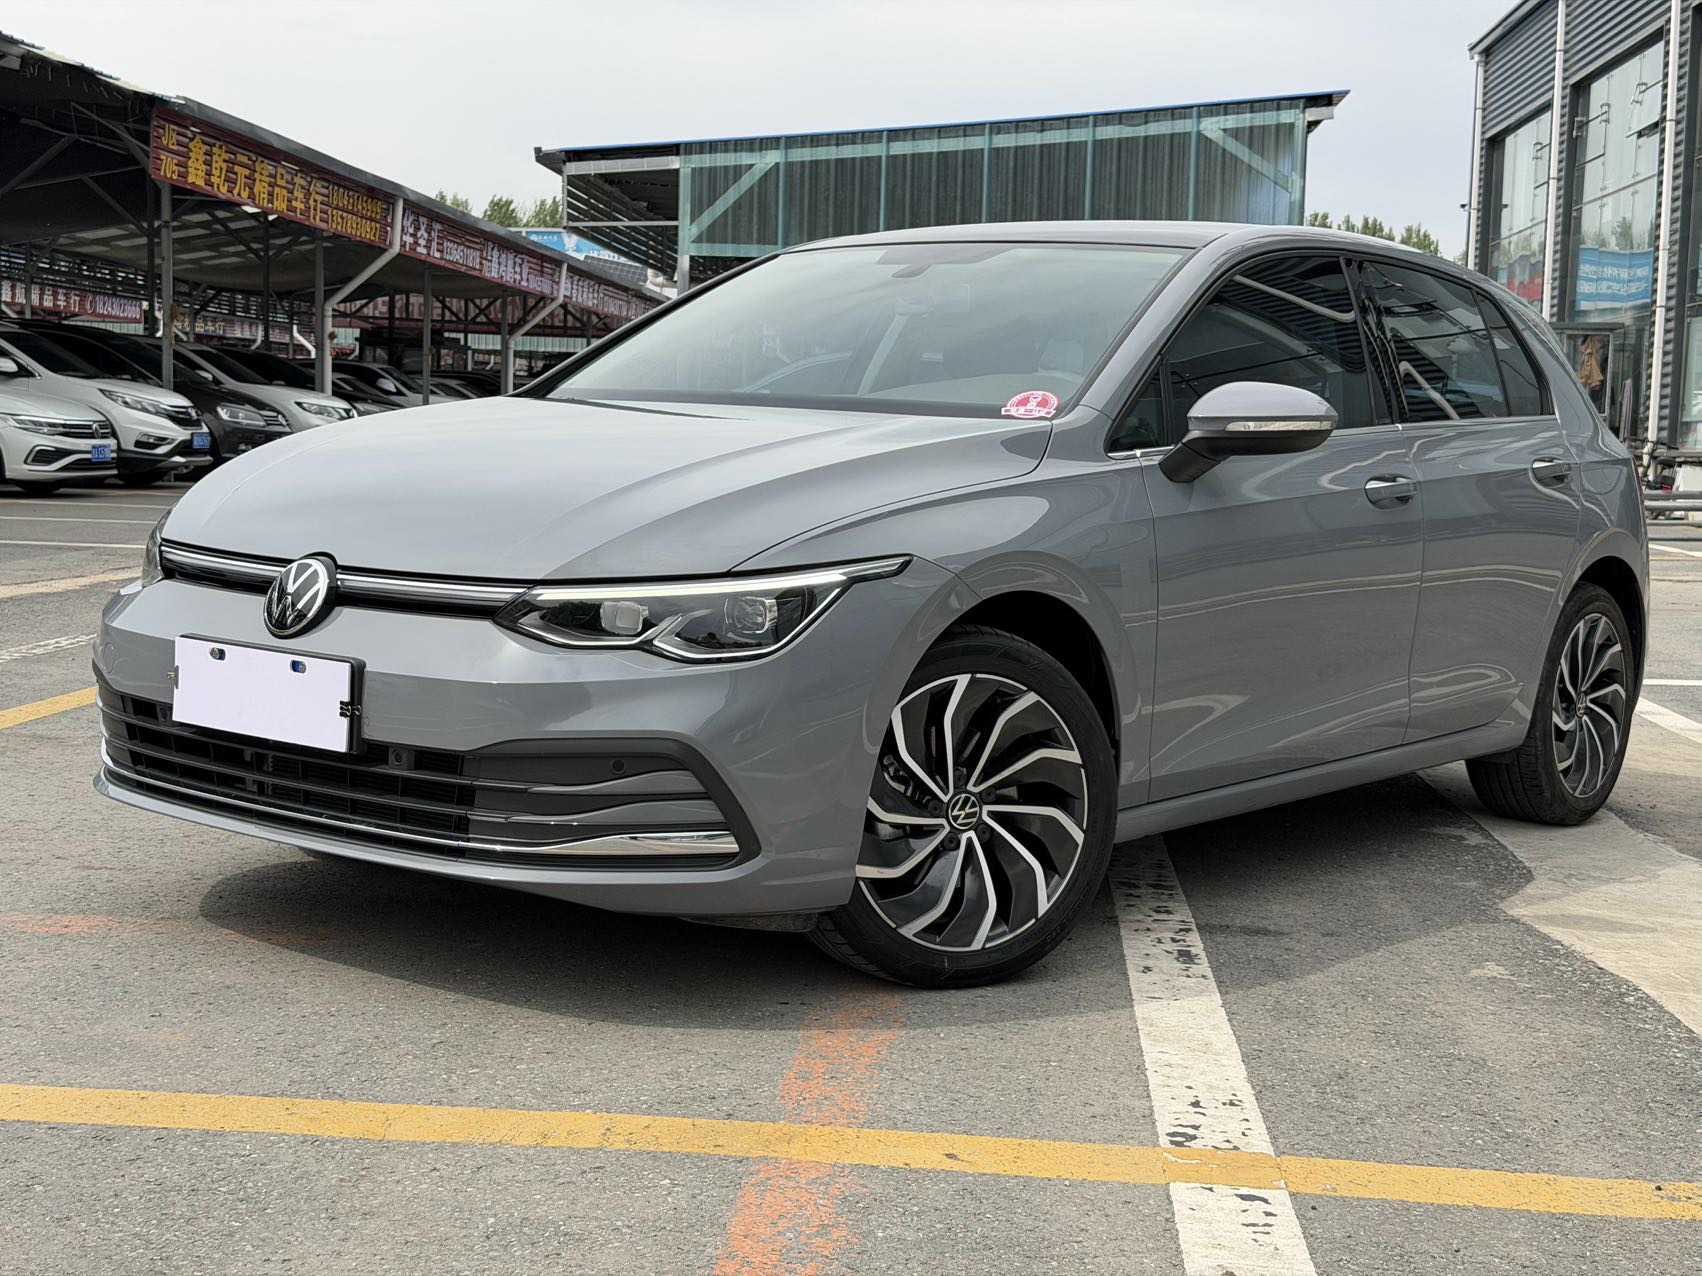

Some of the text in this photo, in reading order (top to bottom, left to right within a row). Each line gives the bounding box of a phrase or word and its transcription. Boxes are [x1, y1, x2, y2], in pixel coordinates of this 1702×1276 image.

[161, 123, 178, 151] J区
[160, 155, 179, 180] 705
[187, 134, 324, 225] 鑫乾元精品车行
